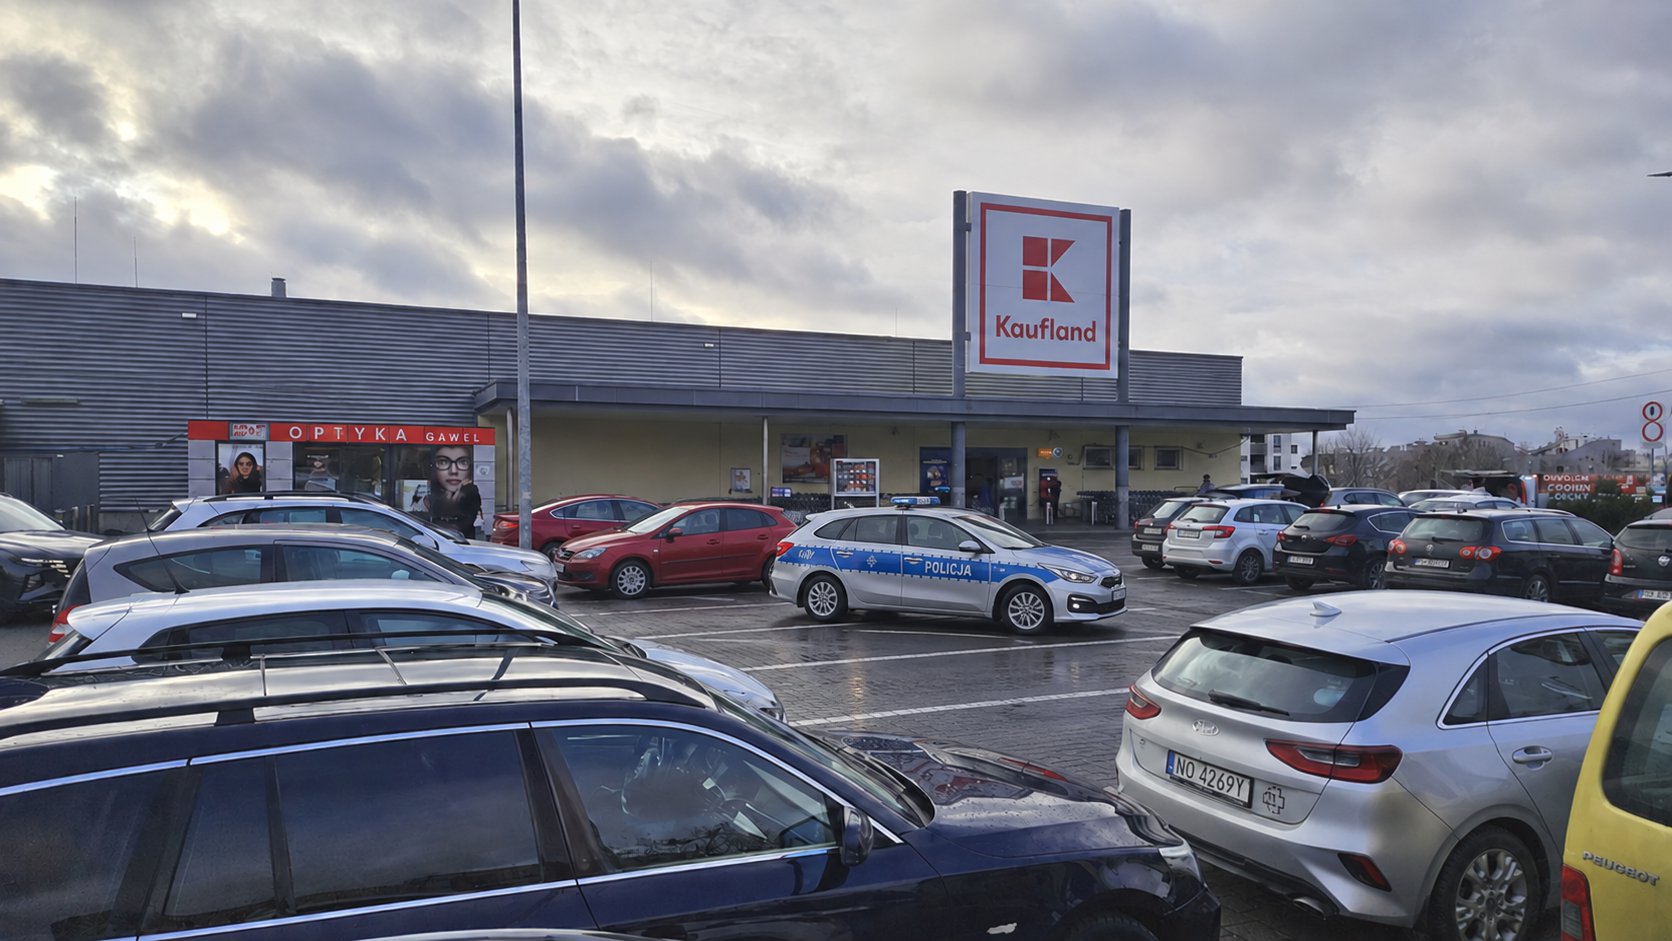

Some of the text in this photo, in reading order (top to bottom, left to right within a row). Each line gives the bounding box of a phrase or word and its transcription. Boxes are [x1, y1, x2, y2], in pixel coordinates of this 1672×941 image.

[1022, 235, 1076, 303] K
[995, 315, 1097, 342] Kaufland
[289, 426, 407, 441] OPTYKA
[924, 561, 972, 577] POLICJA
[1176, 758, 1245, 797] NO 4269Y
[1583, 850, 1660, 886] PEUGEOT
